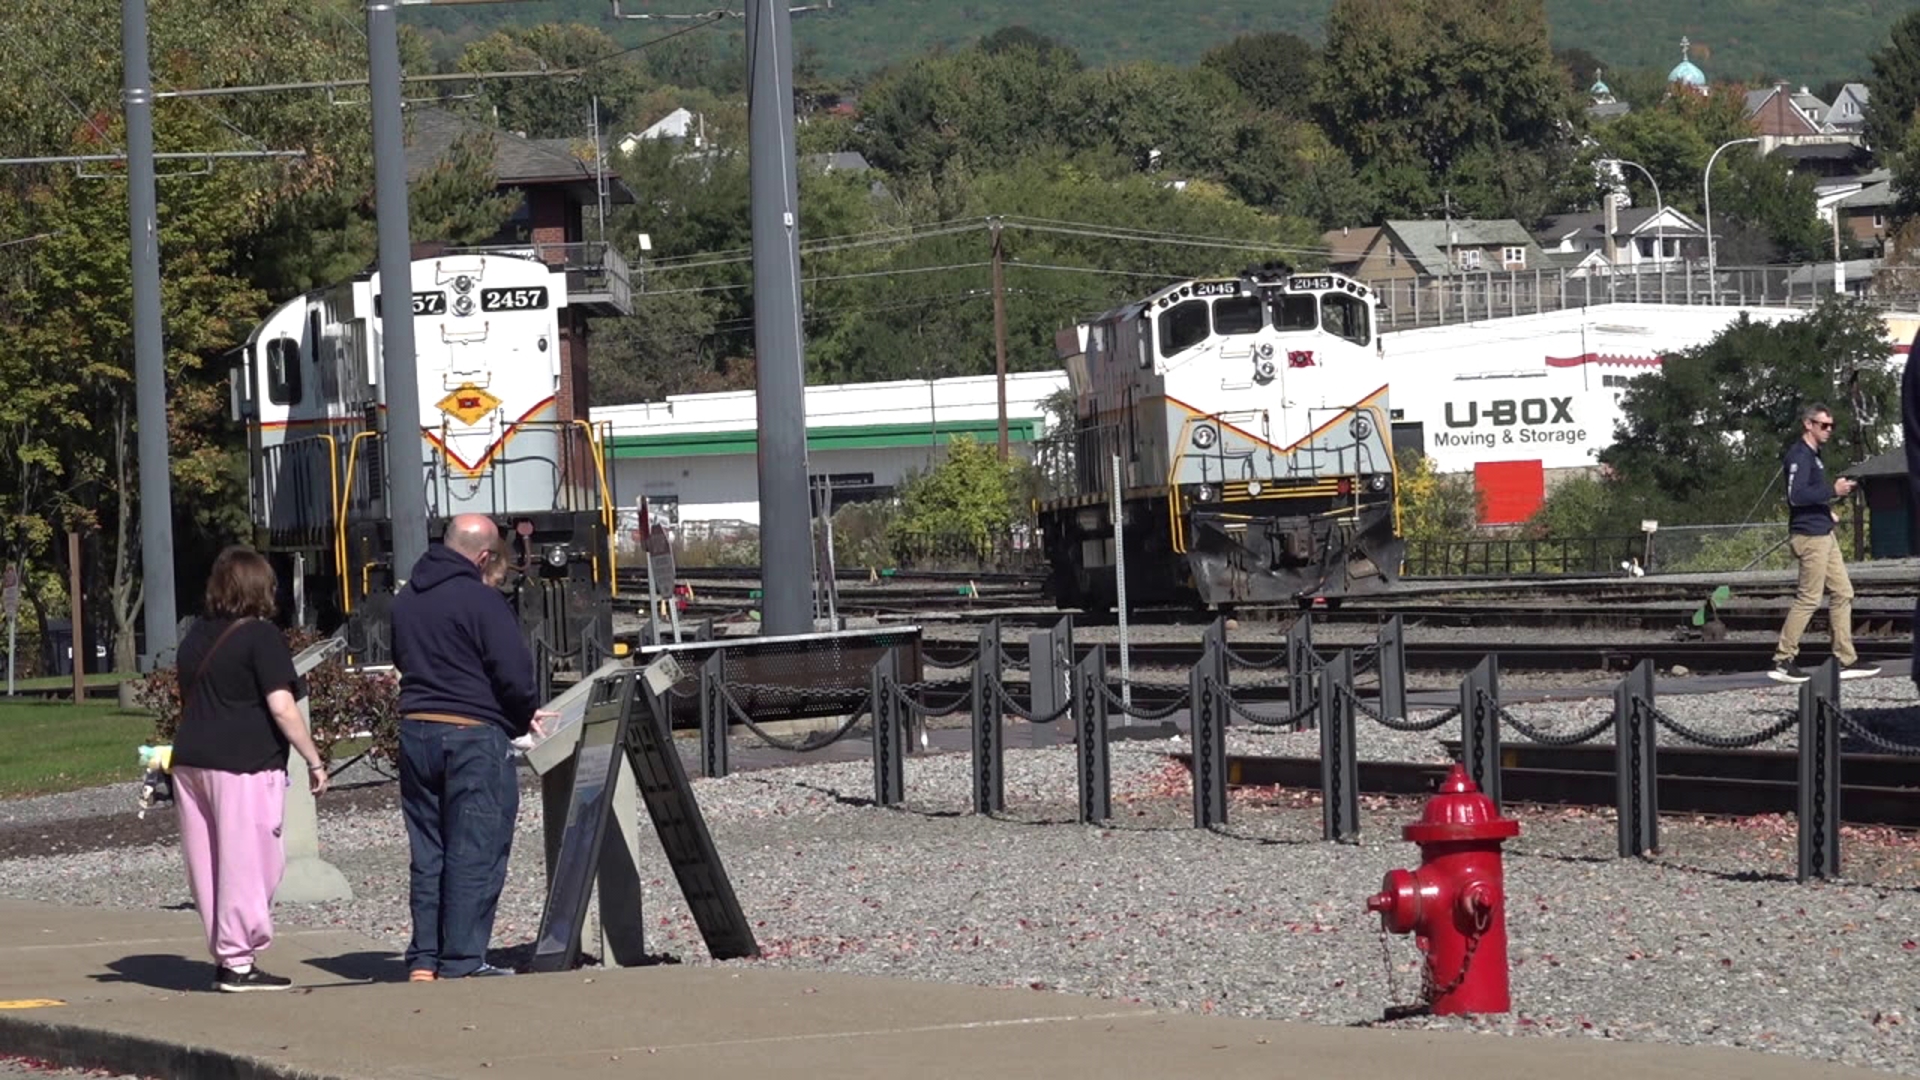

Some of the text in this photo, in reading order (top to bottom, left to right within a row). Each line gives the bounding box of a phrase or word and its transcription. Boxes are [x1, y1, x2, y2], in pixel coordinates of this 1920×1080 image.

[1197, 283, 1234, 295] 2045
[1294, 278, 1329, 289] 2045
[486, 290, 541, 309] 2457
[1444, 396, 1575, 429] U-BOX
[1434, 428, 1587, 448] Moving & Storage
